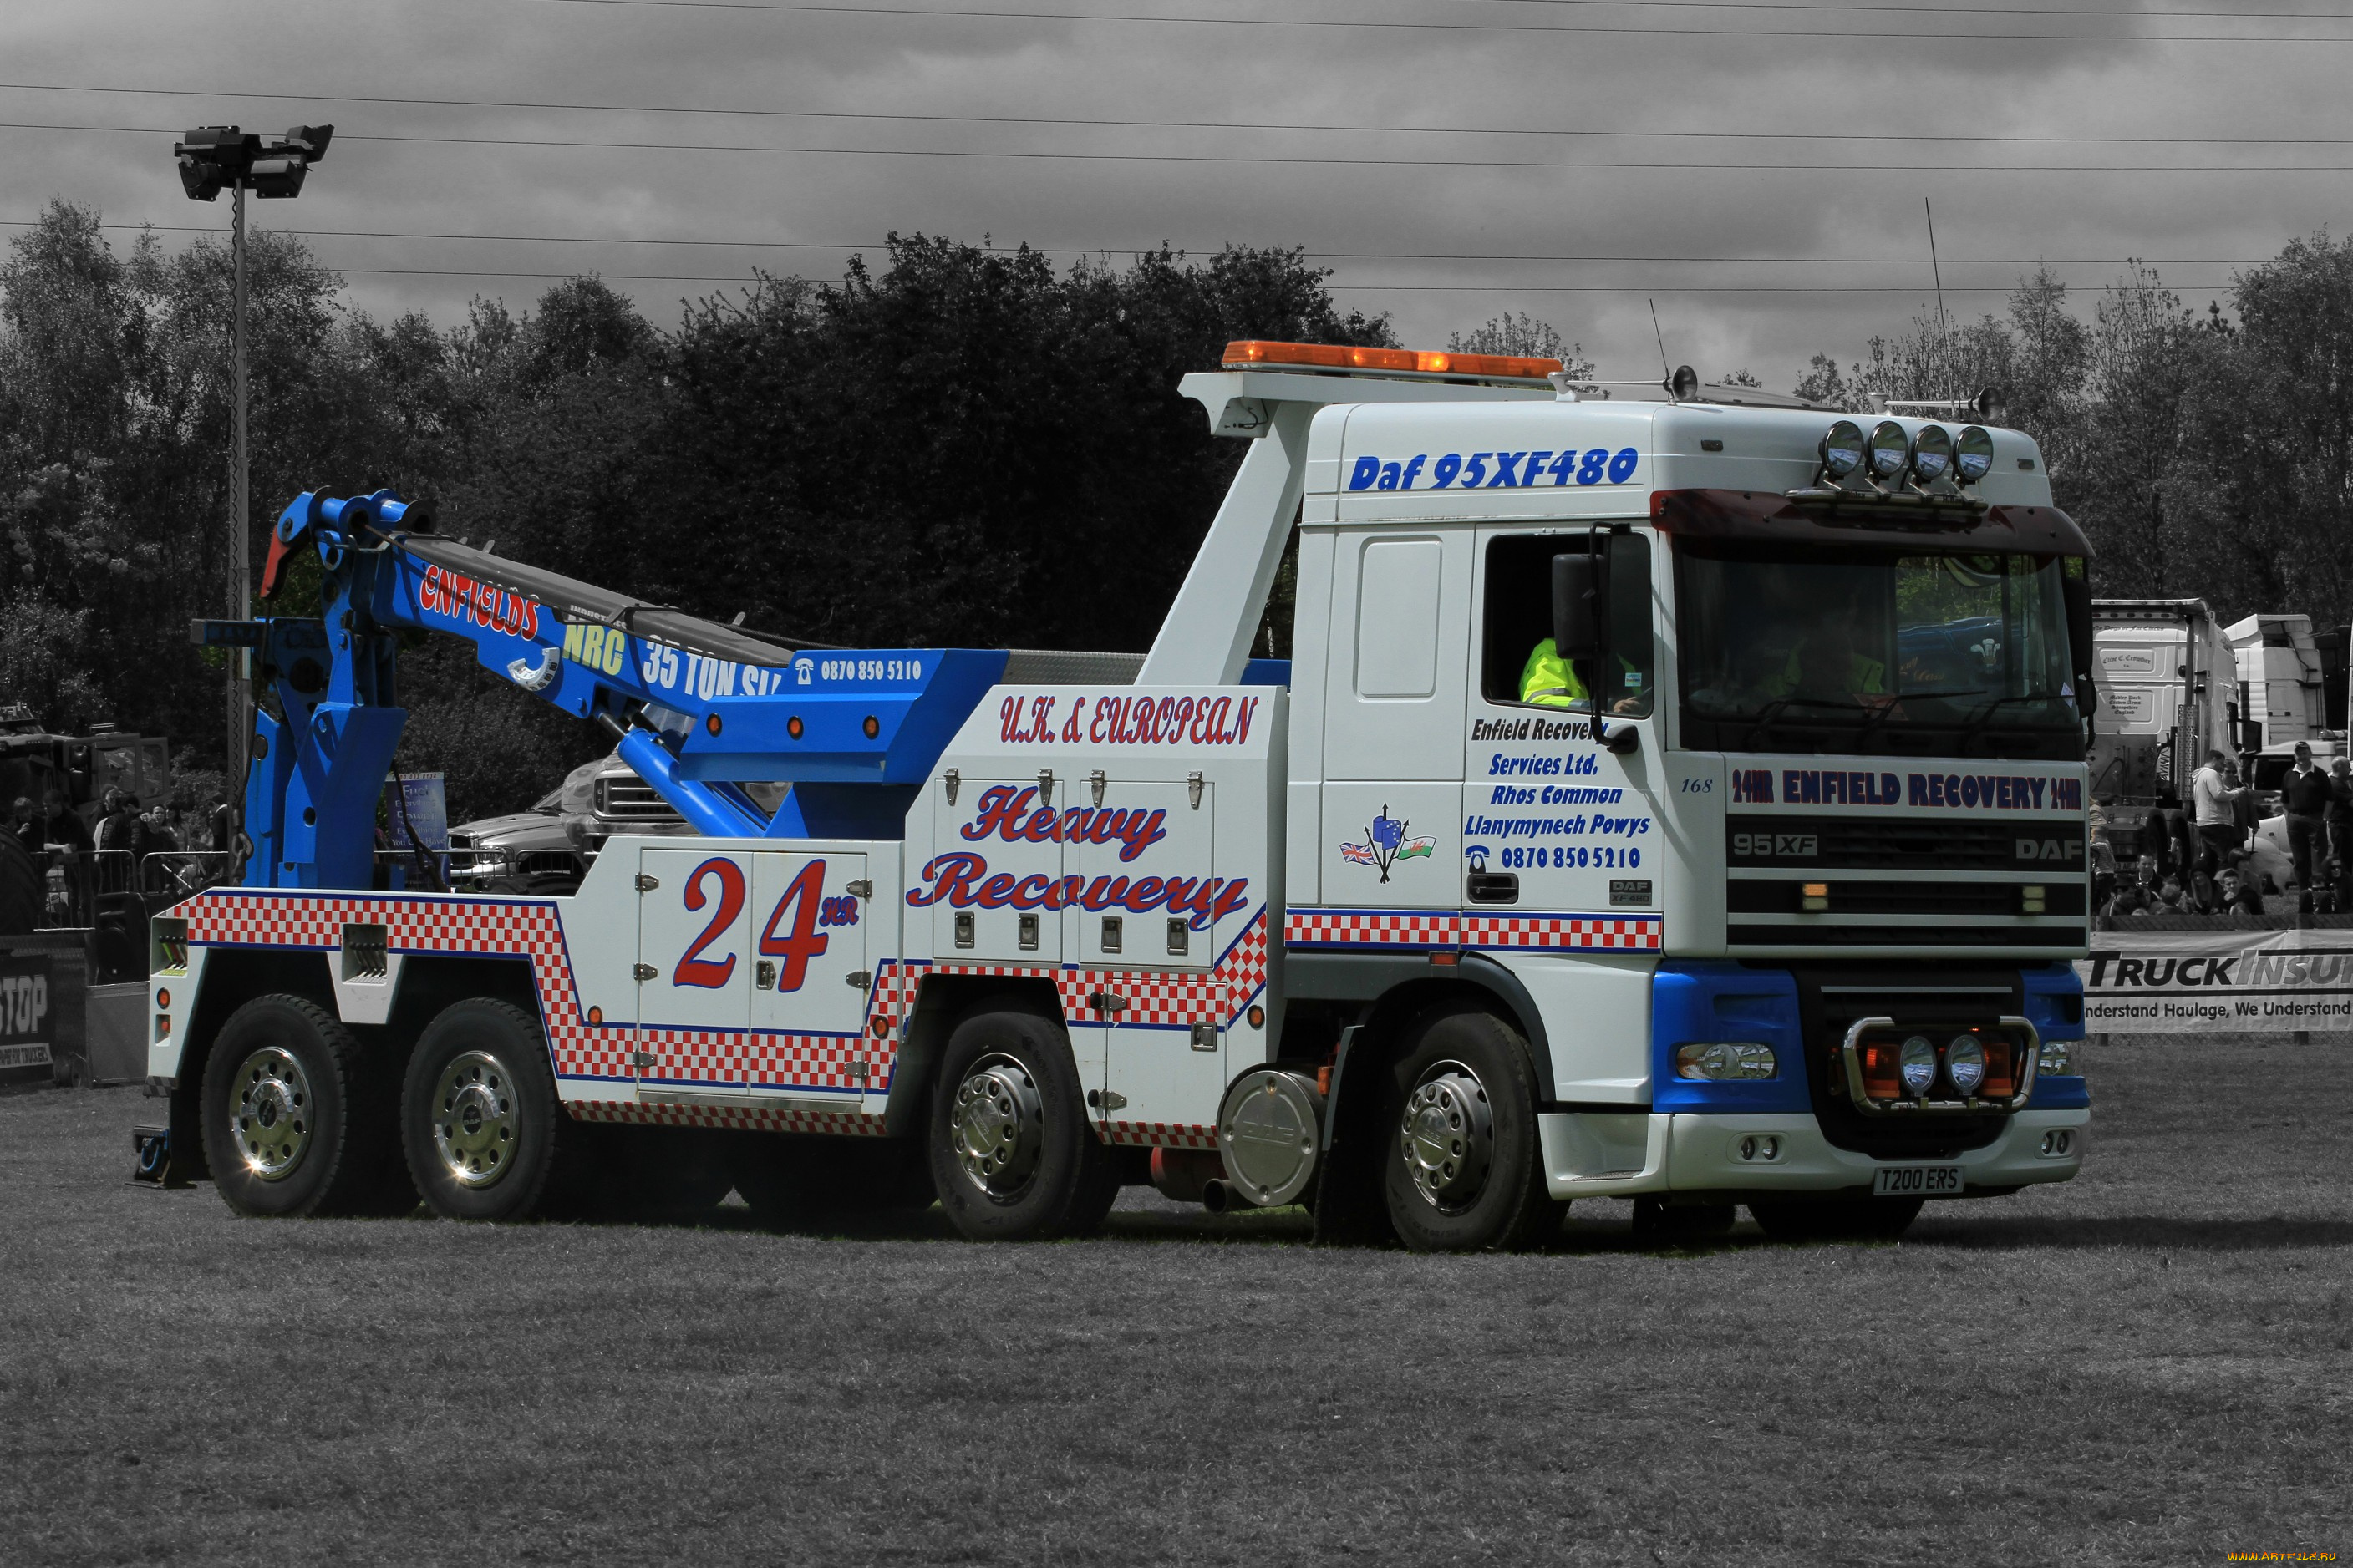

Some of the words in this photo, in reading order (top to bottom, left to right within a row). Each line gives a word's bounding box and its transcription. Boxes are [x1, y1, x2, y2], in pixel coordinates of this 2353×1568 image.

[1349, 454, 1427, 490] Daf
[1430, 447, 1639, 489] 95XF480
[419, 564, 541, 642] ENFIELDS
[561, 615, 626, 676] NRC
[643, 634, 681, 689] 35
[684, 646, 737, 701] TON
[821, 660, 856, 681] 0870
[858, 660, 884, 680] 850
[887, 660, 922, 680] 5210
[1000, 696, 1055, 743] U.K.
[1089, 696, 1259, 745] EUROPEAN
[1471, 718, 1531, 741] Enfield
[1488, 753, 1562, 775] Services
[1564, 753, 1598, 775] Ltd.
[1490, 785, 1537, 805] Rhos
[1541, 784, 1623, 804] Common
[1681, 778, 1713, 793] 168
[1782, 770, 1902, 806] ENFIELD
[1908, 773, 2047, 810] RECOVERY
[959, 784, 1168, 863] Heavy
[1464, 814, 1586, 839] Llanymynech
[1589, 814, 1650, 838] Powys
[1501, 847, 1548, 869] 0870
[1553, 847, 1588, 869] 850
[1593, 847, 1640, 869] 5210
[2015, 838, 2083, 860] DAF
[905, 851, 1249, 932] Recovery
[1612, 881, 1648, 891] DAF
[673, 856, 830, 993] 24
[0, 973, 48, 1035] TOP
[2164, 1002, 2230, 1021] Haulage,
[2235, 1002, 2259, 1017] We
[2264, 1000, 2350, 1017] Understand
[1882, 1170, 1924, 1190] T200
[1926, 1169, 1959, 1190] ERS
